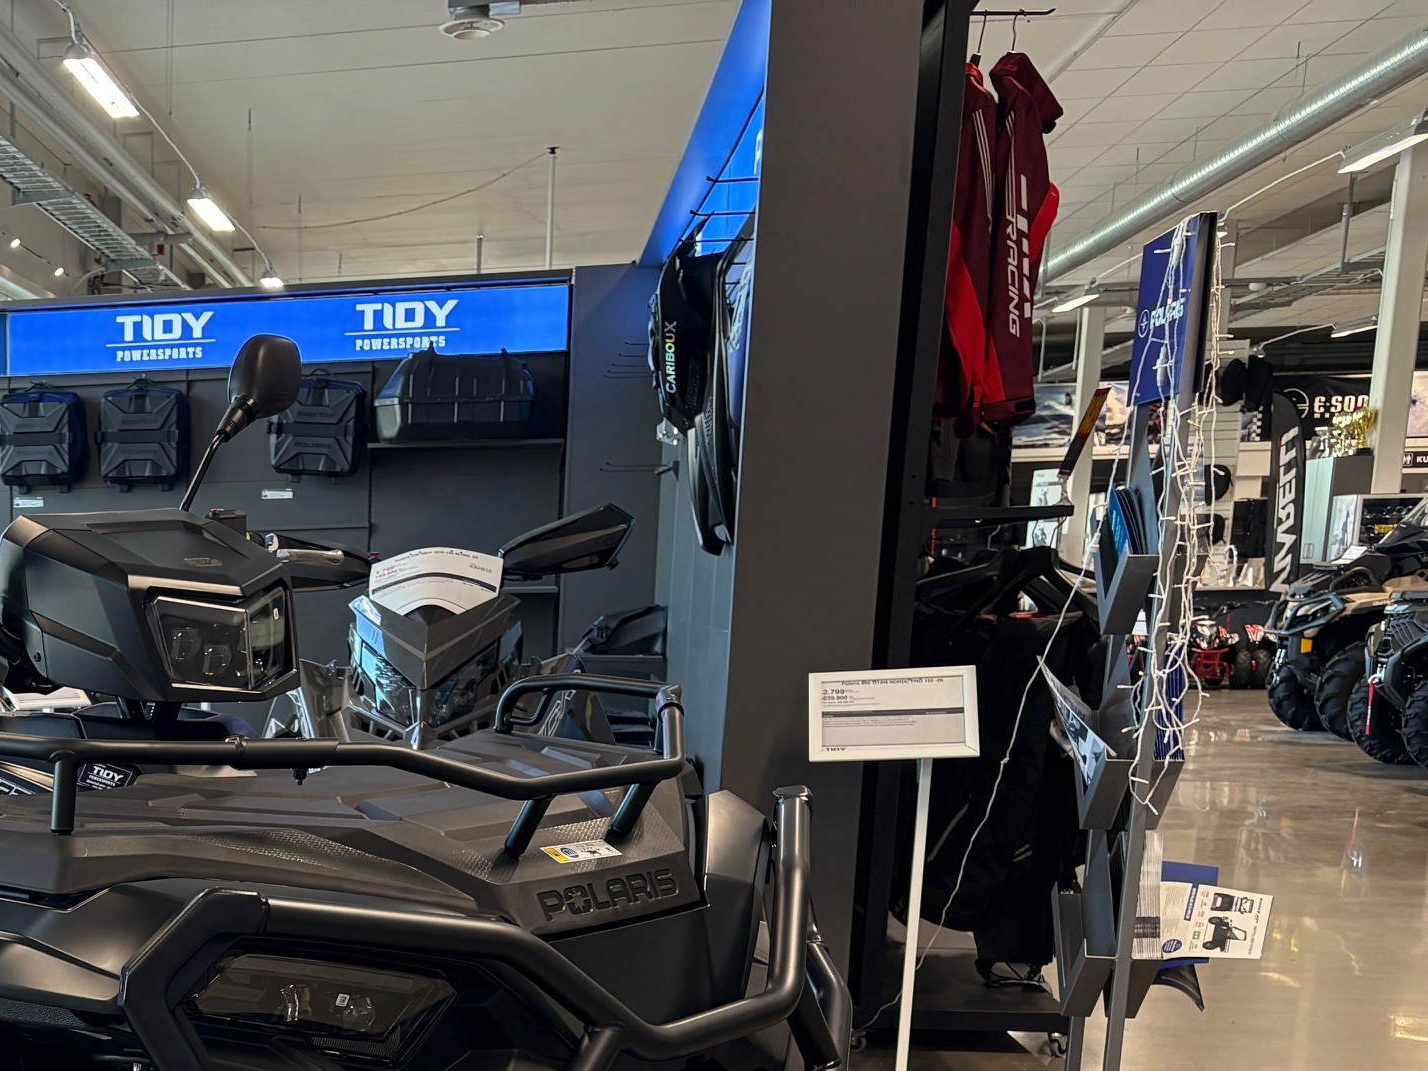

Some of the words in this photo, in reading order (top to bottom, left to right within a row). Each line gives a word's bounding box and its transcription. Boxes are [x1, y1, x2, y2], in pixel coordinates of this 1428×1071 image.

[1006, 214, 1020, 338] RACING
[115, 311, 214, 341] TIDY
[355, 299, 459, 330] TIDY
[115, 346, 203, 362] POWERSPORTS
[355, 336, 446, 351] POWERSPORTS
[665, 320, 677, 394] CARIBOUX
[93, 765, 124, 782] TIDY
[537, 868, 679, 922] POLARIS
